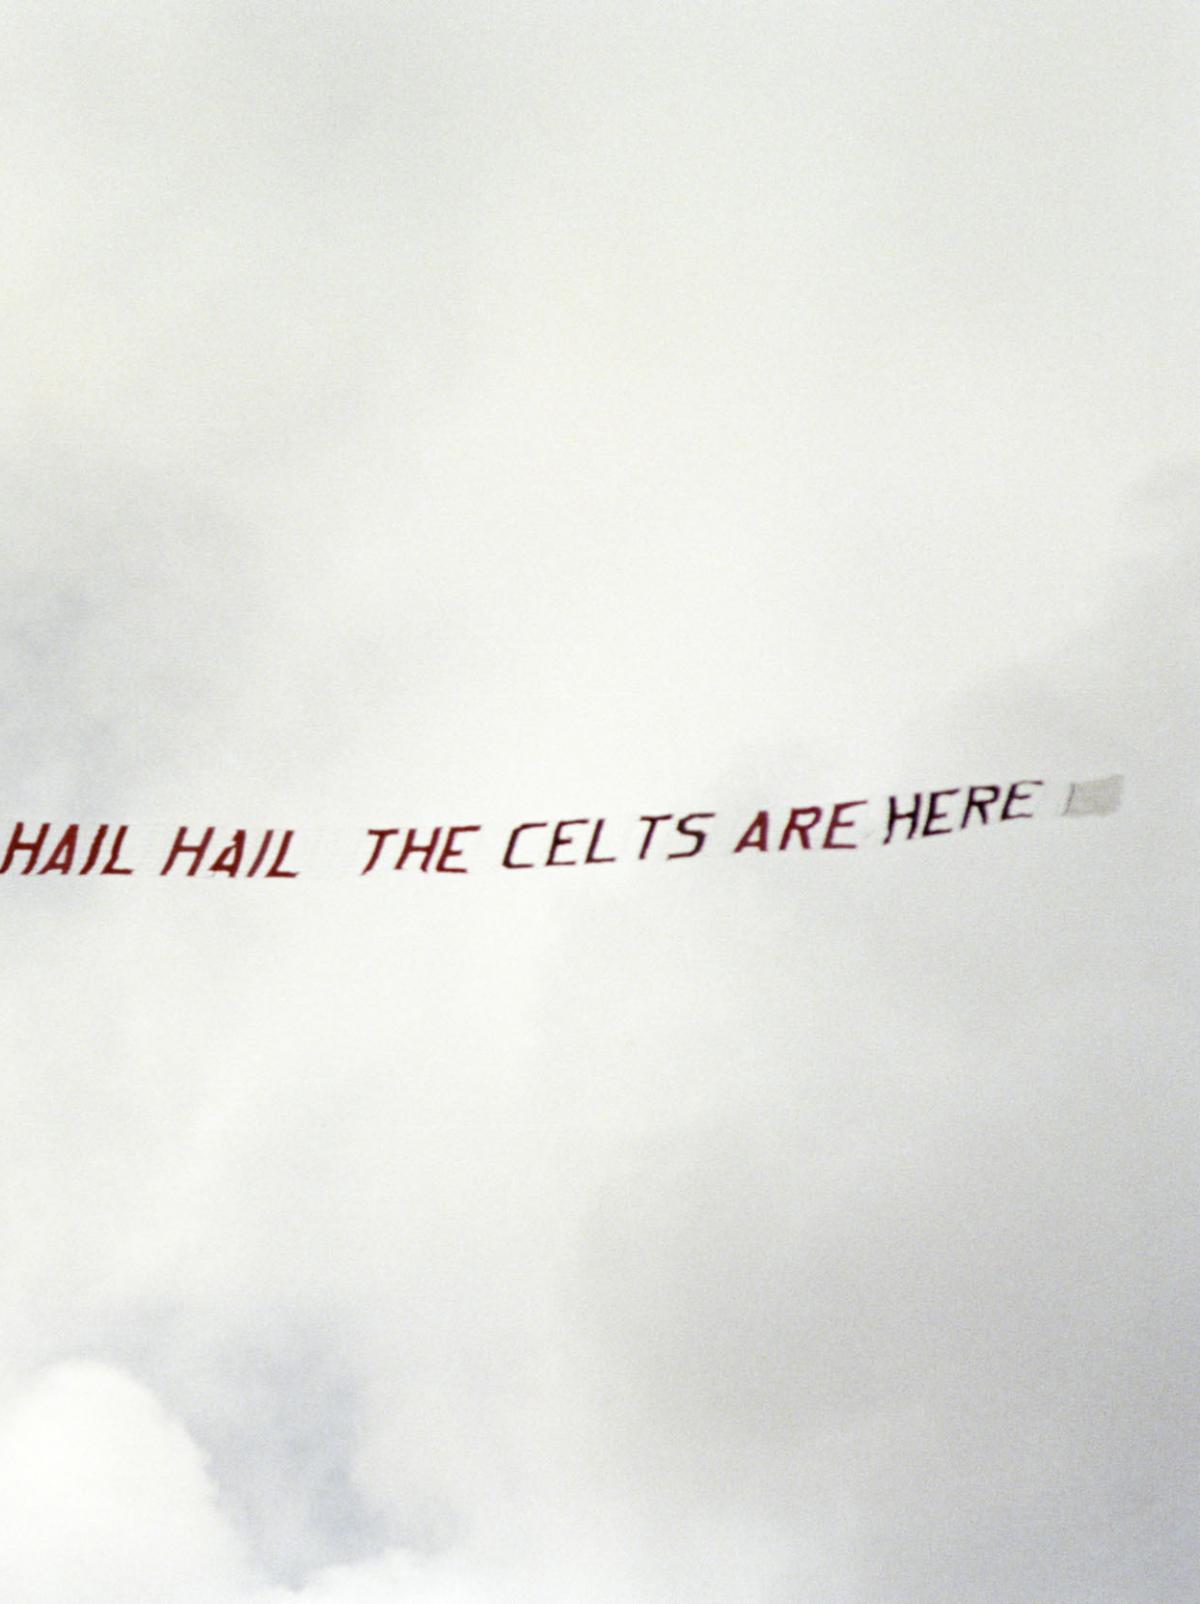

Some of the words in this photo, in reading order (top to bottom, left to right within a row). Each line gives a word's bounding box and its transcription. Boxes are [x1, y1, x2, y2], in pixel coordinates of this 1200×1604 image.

[160, 826, 297, 878] HAIL
[362, 825, 481, 875] THE
[502, 812, 715, 869] CELTS
[733, 800, 867, 854] ARE
[882, 780, 1044, 845] HERE
